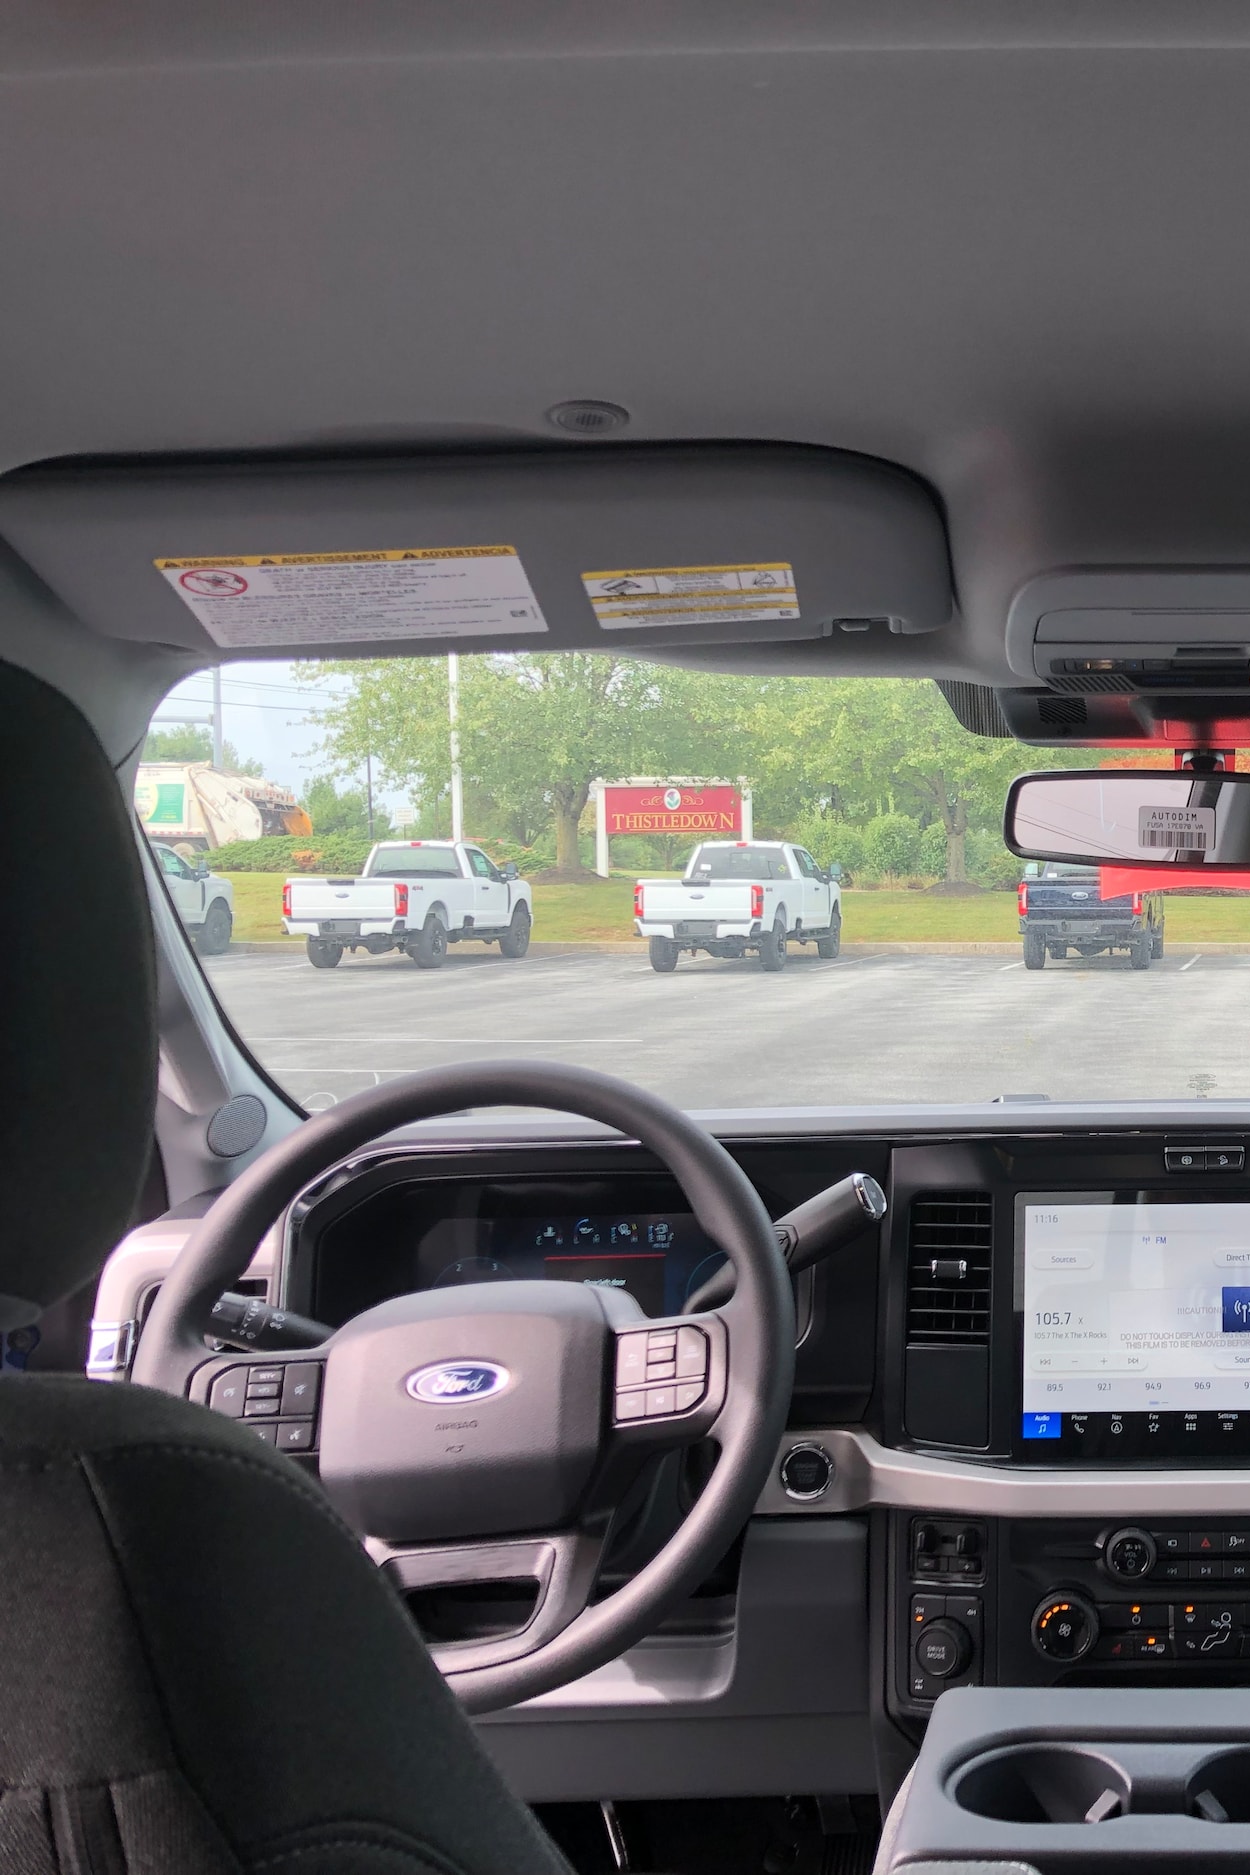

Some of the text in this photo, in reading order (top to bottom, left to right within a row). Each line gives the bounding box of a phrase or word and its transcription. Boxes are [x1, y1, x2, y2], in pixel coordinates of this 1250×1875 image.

[421, 548, 511, 558] ADVERTENCIA
[1151, 812, 1198, 821] AUTODIM
[612, 813, 735, 830] THISTLEDOWN
[1034, 1215, 1059, 1224] 11:16
[1051, 1255, 1077, 1263] Sources
[1035, 1312, 1071, 1325] 105.7
[1120, 1333, 1131, 1341] DO
[1149, 1332, 1174, 1340] TOUCH
[1143, 1341, 1160, 1349] FILM
[1161, 1341, 1168, 1349] IS
[1180, 1340, 1190, 1348] BE
[431, 1369, 483, 1394] Ford
[1194, 1382, 1211, 1390] 96.9
[1097, 1383, 1112, 1391] 92.1
[1184, 1413, 1198, 1421] Apps
[1217, 1412, 1239, 1420] Settings
[434, 1420, 479, 1430] AIRBAG
[926, 1645, 946, 1653] DRIVE
